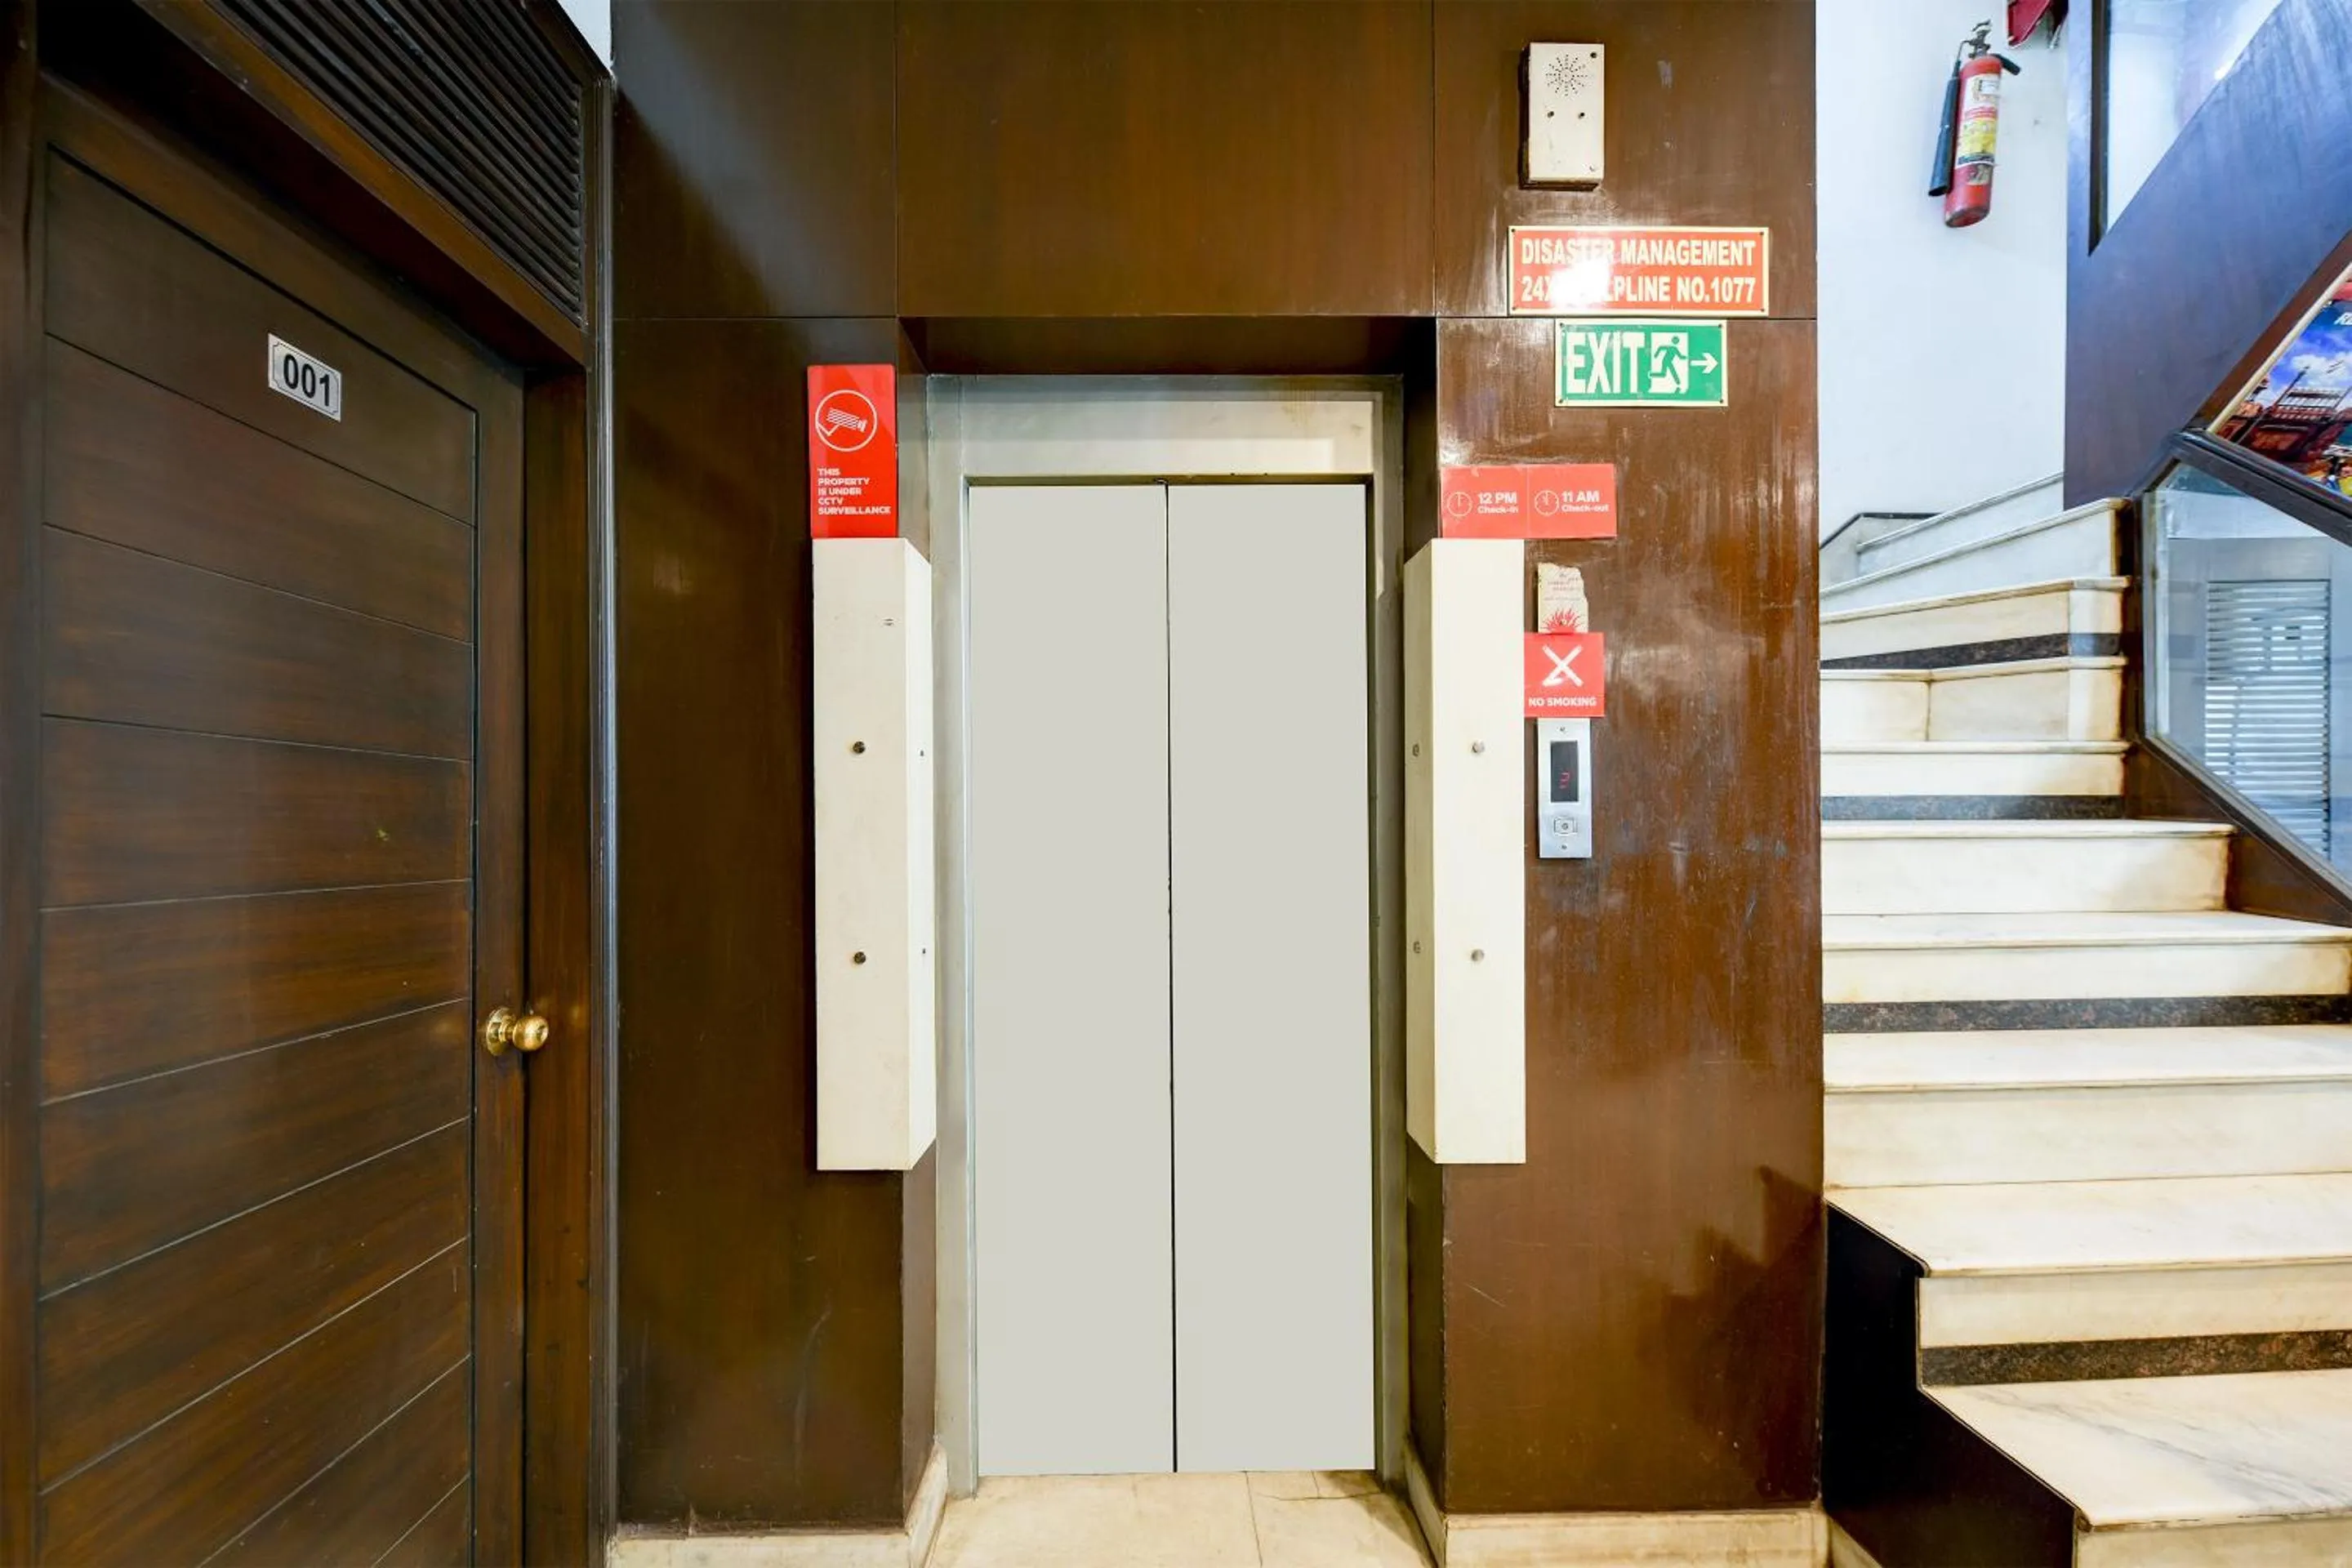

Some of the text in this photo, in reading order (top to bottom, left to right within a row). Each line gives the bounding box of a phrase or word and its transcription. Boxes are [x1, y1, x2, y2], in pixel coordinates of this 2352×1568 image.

[1521, 237, 1756, 266] DISASTER MANAGEMENT
[1677, 276, 1756, 303] NO.1077
[1566, 331, 1645, 394] EXIT
[283, 354, 330, 407] 001
[817, 467, 840, 476] THIS
[818, 477, 870, 486] PROPERTY
[818, 487, 862, 496] IS UNDER
[1561, 490, 1600, 502] 11 AM
[818, 497, 843, 506] CCTV
[1477, 492, 1517, 504] 12 PM
[818, 506, 891, 515] SURVEILLANCE
[1477, 506, 1519, 514] Check-in
[1561, 504, 1609, 512] Check-out
[1528, 697, 1597, 706] NO SMOKING
